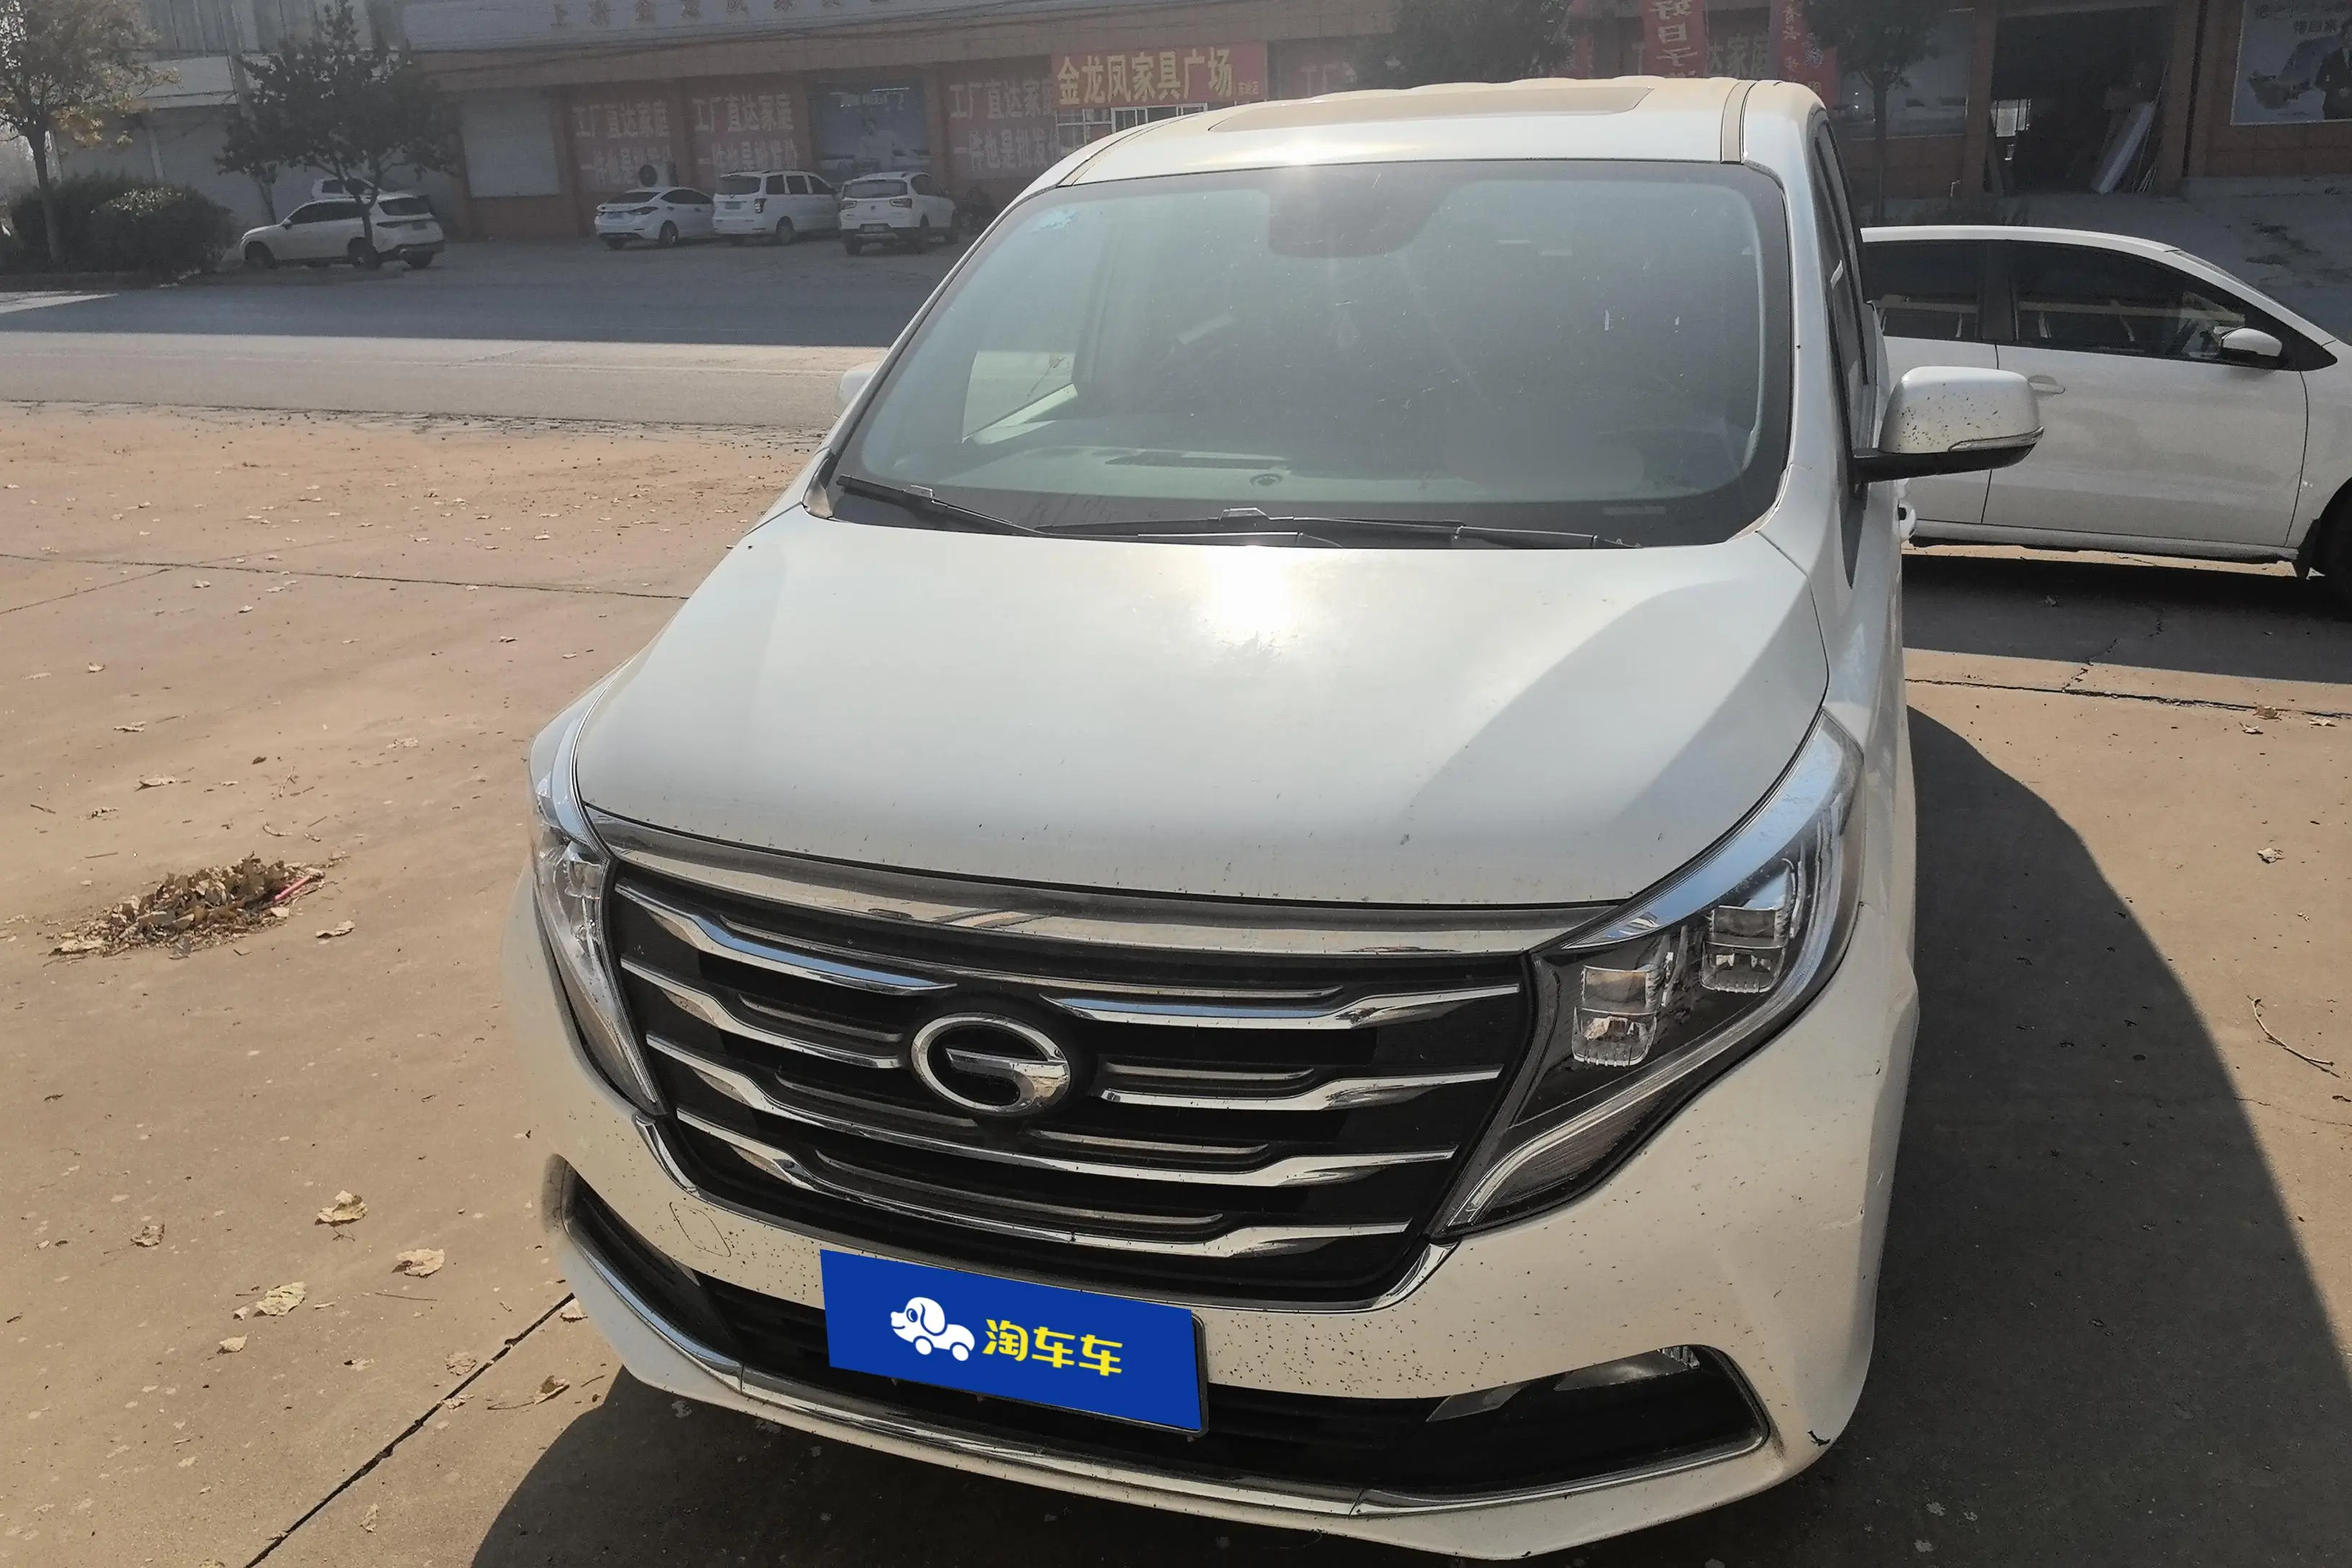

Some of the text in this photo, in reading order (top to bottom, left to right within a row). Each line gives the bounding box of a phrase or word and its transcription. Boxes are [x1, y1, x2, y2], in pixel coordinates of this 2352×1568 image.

[1056, 47, 1233, 104] 金龙凤家具广场
[572, 99, 669, 138] 工厂直达家庭
[692, 91, 794, 133] 工厂直达家庭
